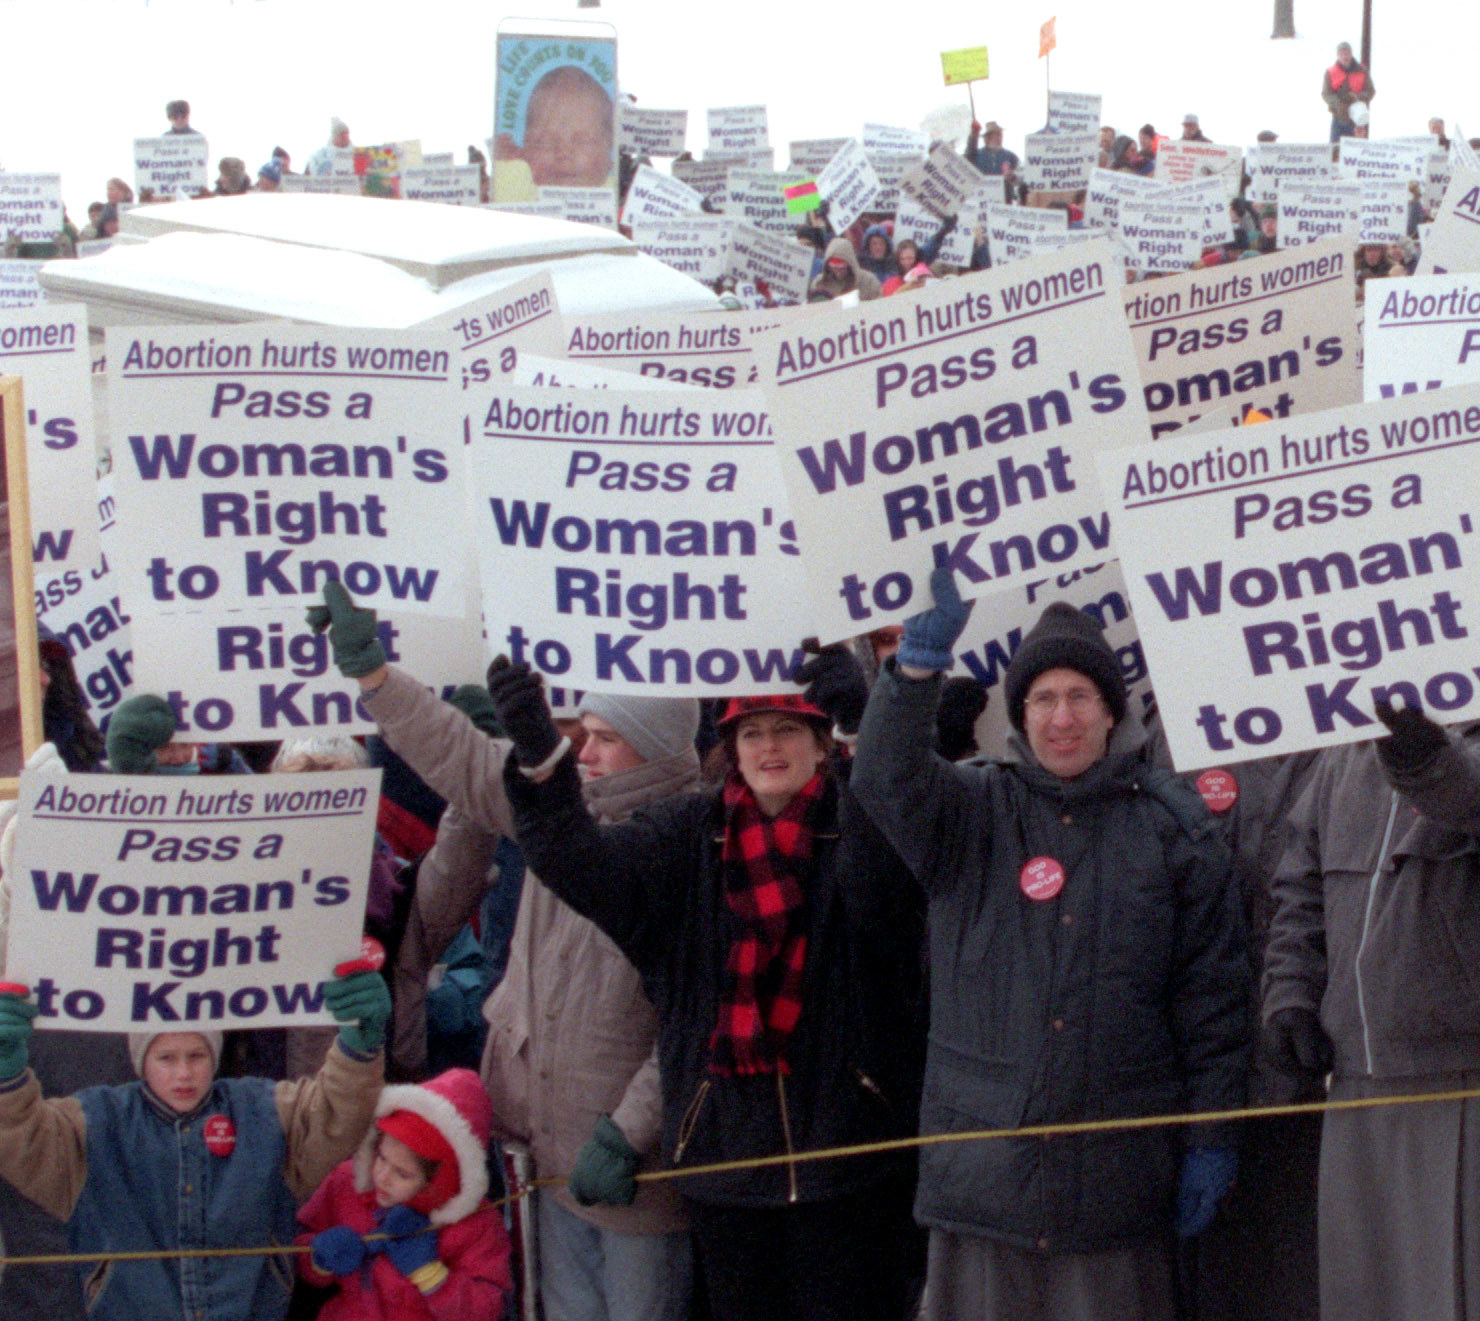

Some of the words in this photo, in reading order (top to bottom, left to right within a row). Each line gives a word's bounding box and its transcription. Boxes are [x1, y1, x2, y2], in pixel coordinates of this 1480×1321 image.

[502, 88, 519, 129] LOVE
[1123, 225, 1198, 240] Woman's
[1283, 205, 1358, 219] Woman's
[1298, 221, 1342, 235] Right
[1140, 241, 1183, 255] Right
[1148, 256, 1196, 269] Know
[486, 286, 552, 332] women
[1124, 288, 1181, 320] rtion
[1189, 274, 1251, 309] hurts
[1261, 252, 1343, 291] women
[0, 321, 75, 349] omen
[568, 326, 671, 351] Abortion
[678, 323, 741, 349] hurts
[777, 314, 907, 376] Abortion
[916, 293, 993, 337] hurts
[1001, 262, 1104, 312] women
[1148, 318, 1248, 361] Pass
[1261, 309, 1284, 334] a
[124, 339, 251, 371] Abortion
[261, 338, 337, 370] hurts
[347, 346, 449, 374] women
[501, 346, 518, 374] a
[876, 347, 997, 408] Pass
[1011, 335, 1038, 370] a
[1143, 334, 1343, 412] oman's
[210, 382, 331, 419] Pass
[344, 391, 373, 420] a
[485, 398, 609, 435] Abortion
[619, 404, 700, 437] hurts
[796, 371, 1127, 495] Woman's
[128, 433, 449, 483] Woman's
[565, 450, 690, 491] Pass
[706, 462, 737, 491] a
[1122, 447, 1268, 500] Abortion
[1281, 426, 1370, 469] hurts
[201, 490, 388, 544] Right
[883, 446, 1076, 542] Right
[1234, 481, 1372, 539] Pass
[1391, 473, 1422, 508] a
[146, 557, 220, 601] to
[244, 550, 439, 602] Know
[555, 566, 747, 630] Right
[840, 571, 913, 621] to
[216, 620, 402, 677] Rigt
[507, 625, 571, 676] to
[595, 633, 805, 684] Know
[1243, 591, 1468, 676] Right
[166, 690, 234, 732] to
[1197, 704, 1282, 751] to
[34, 784, 166, 816] Abortion
[176, 788, 254, 816] hurts
[264, 785, 368, 813] women
[1205, 777, 1225, 787] GOD
[116, 828, 241, 863] Pass
[252, 833, 284, 860] a
[1028, 861, 1047, 874] GOD
[30, 869, 352, 917] Woman's
[1025, 871, 1061, 894] PRO-LIFE
[94, 925, 282, 979] Right
[32, 978, 106, 1020] to
[130, 981, 328, 1023] Know
